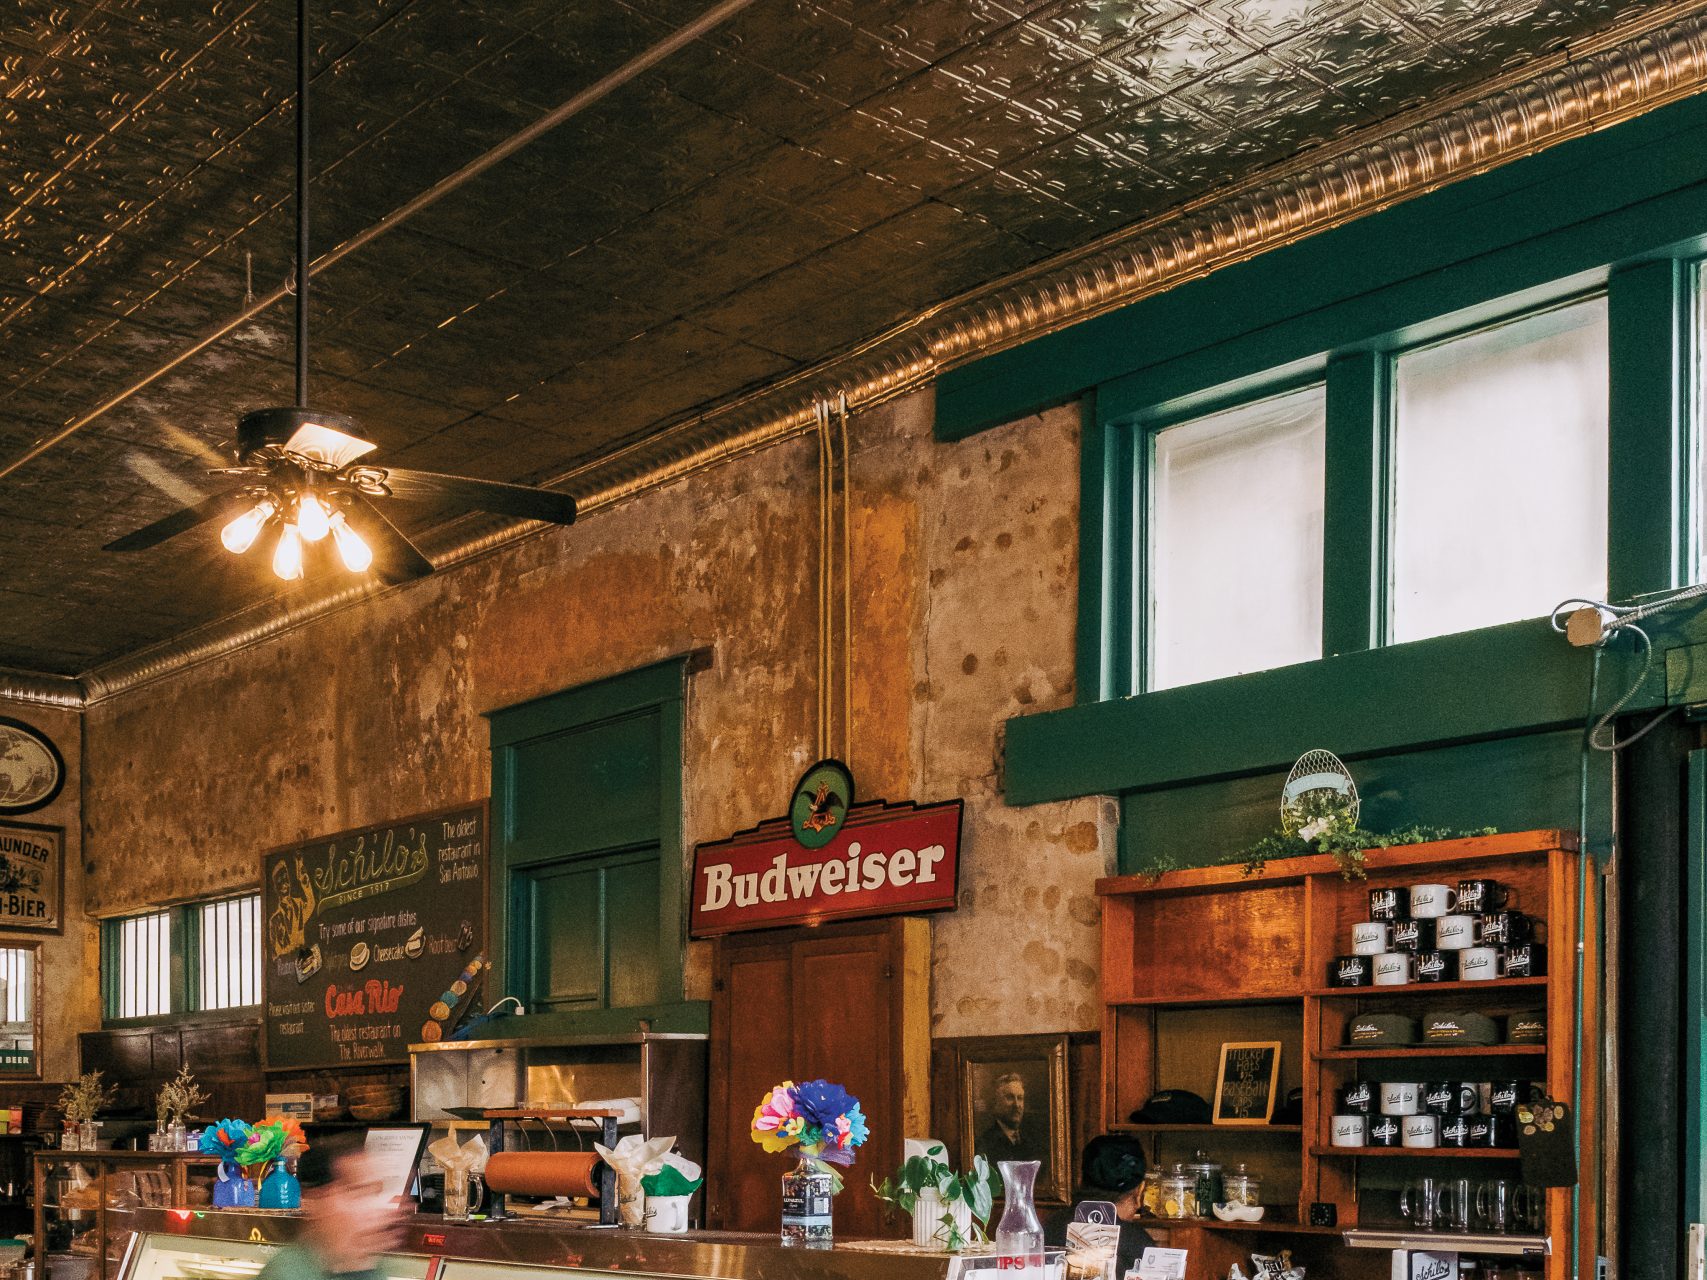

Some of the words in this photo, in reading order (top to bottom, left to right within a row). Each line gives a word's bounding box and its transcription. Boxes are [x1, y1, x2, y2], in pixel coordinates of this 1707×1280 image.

[443, 821, 456, 841] The
[456, 817, 477, 838] oldest
[0, 837, 49, 863] UNDER
[315, 828, 429, 895] Schilo's
[438, 844, 472, 862] restaurant
[473, 841, 481, 856] in
[700, 842, 946, 912] Budweiser
[339, 890, 363, 904] SINCE
[371, 883, 389, 896] 1917
[319, 923, 330, 945] Try
[347, 917, 354, 934] of
[325, 984, 365, 1018] Casa
[365, 980, 404, 1014] Rio
[329, 1024, 340, 1042] The
[6, 1055, 29, 1065] BEER
[339, 1044, 350, 1060] The
